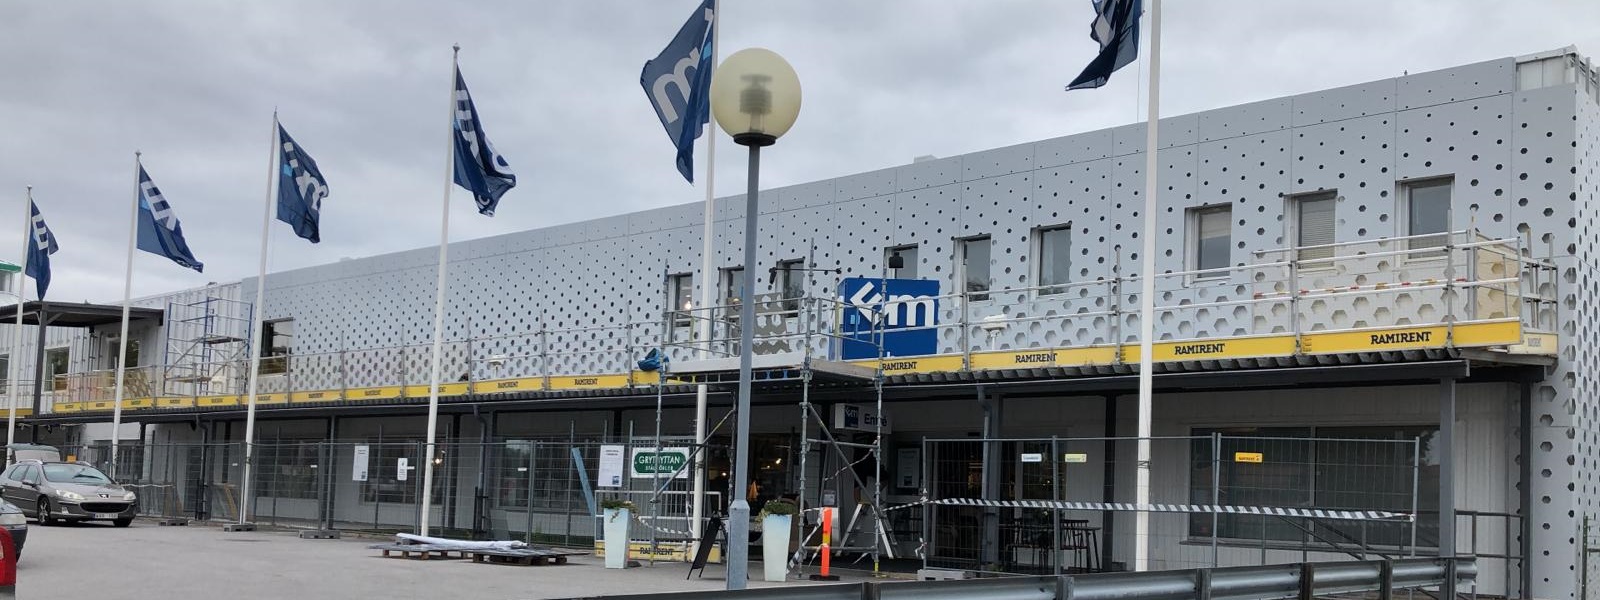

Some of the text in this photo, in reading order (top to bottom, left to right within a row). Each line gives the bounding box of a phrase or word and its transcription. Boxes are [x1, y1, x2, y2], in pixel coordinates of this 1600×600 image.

[1371, 331, 1432, 345] RAMIRENT
[1175, 343, 1225, 355] RAMIRENT
[1015, 353, 1058, 363] RAMIRENT
[882, 361, 918, 371] RAMIRENT
[639, 455, 681, 465] GRYTYTTAN
[645, 464, 673, 472] STÅLÖBLER
[640, 547, 674, 556] RAIRENT
